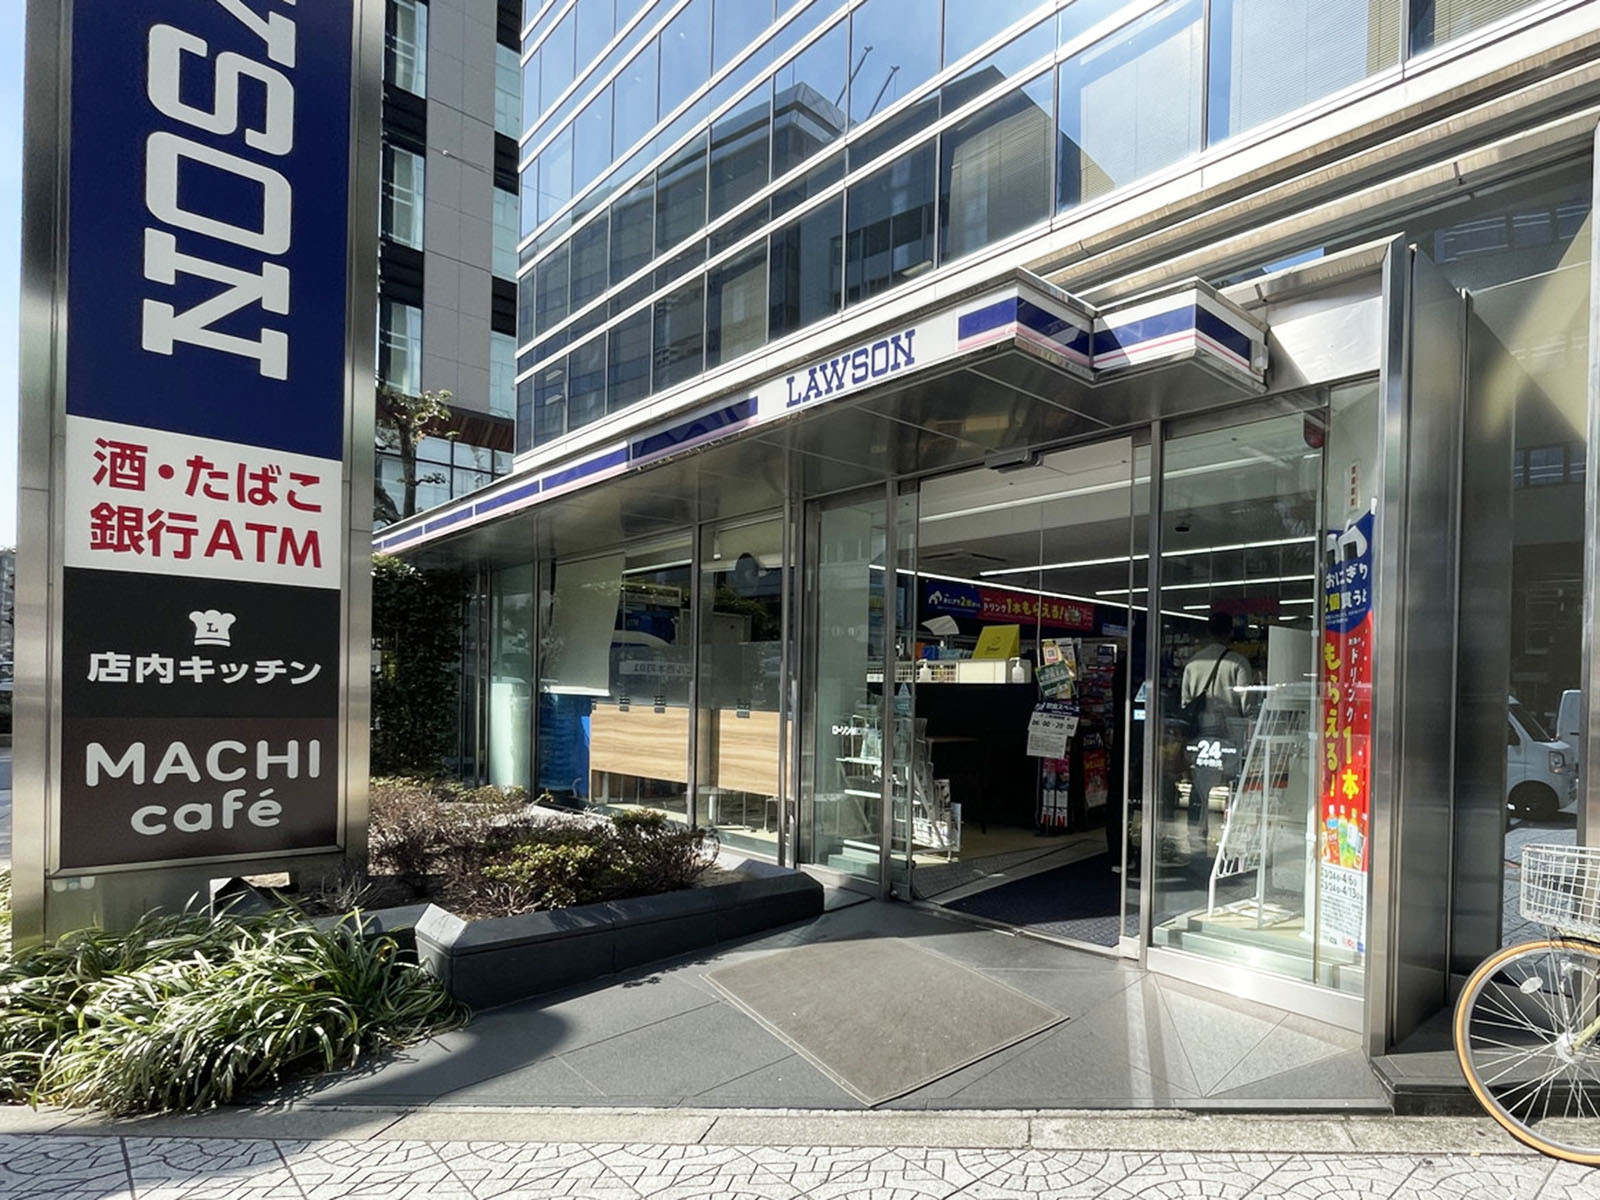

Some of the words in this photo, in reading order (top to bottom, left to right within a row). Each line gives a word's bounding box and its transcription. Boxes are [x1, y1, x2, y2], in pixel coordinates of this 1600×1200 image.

[786, 328, 916, 407] LAWSON
[92, 437, 323, 513] 酒・たばこ
[90, 502, 323, 568] 銀行ATM
[1325, 563, 1368, 589] おにぎり
[206, 622, 219, 633] L
[87, 652, 322, 684] 店内キッチン
[86, 739, 321, 787] MACHI
[1197, 740, 1221, 759] 24
[131, 787, 282, 835] café
